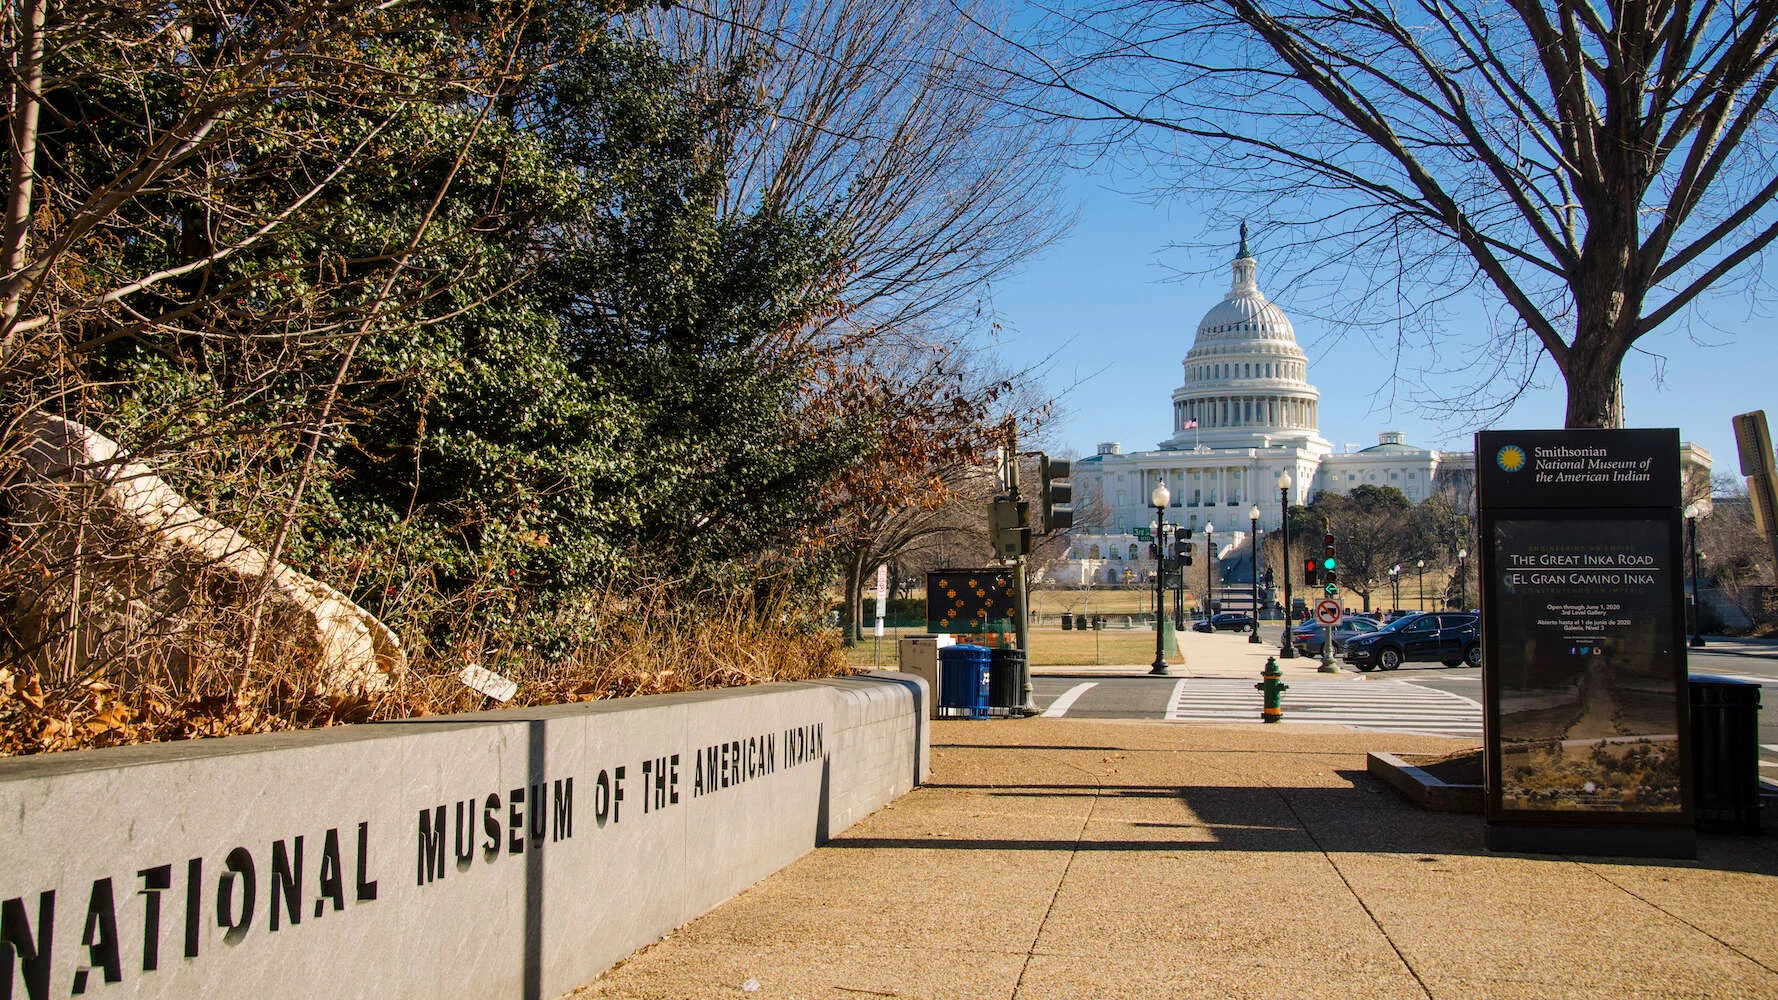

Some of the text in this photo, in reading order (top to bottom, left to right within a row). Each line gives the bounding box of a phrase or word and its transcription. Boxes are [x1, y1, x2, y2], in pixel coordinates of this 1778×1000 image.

[1534, 446, 1607, 458] Smithsonian
[1535, 457, 1653, 471] National Museum of
[1536, 470, 1650, 482] the American Indian
[1510, 554, 1654, 565] THE GREAT INKA ROAD
[1512, 573, 1655, 585] EL GRAN CAMINO INKA
[0, 723, 824, 1000] NATIONAL MUSEUM OF THE AMERICAN INDIAN
